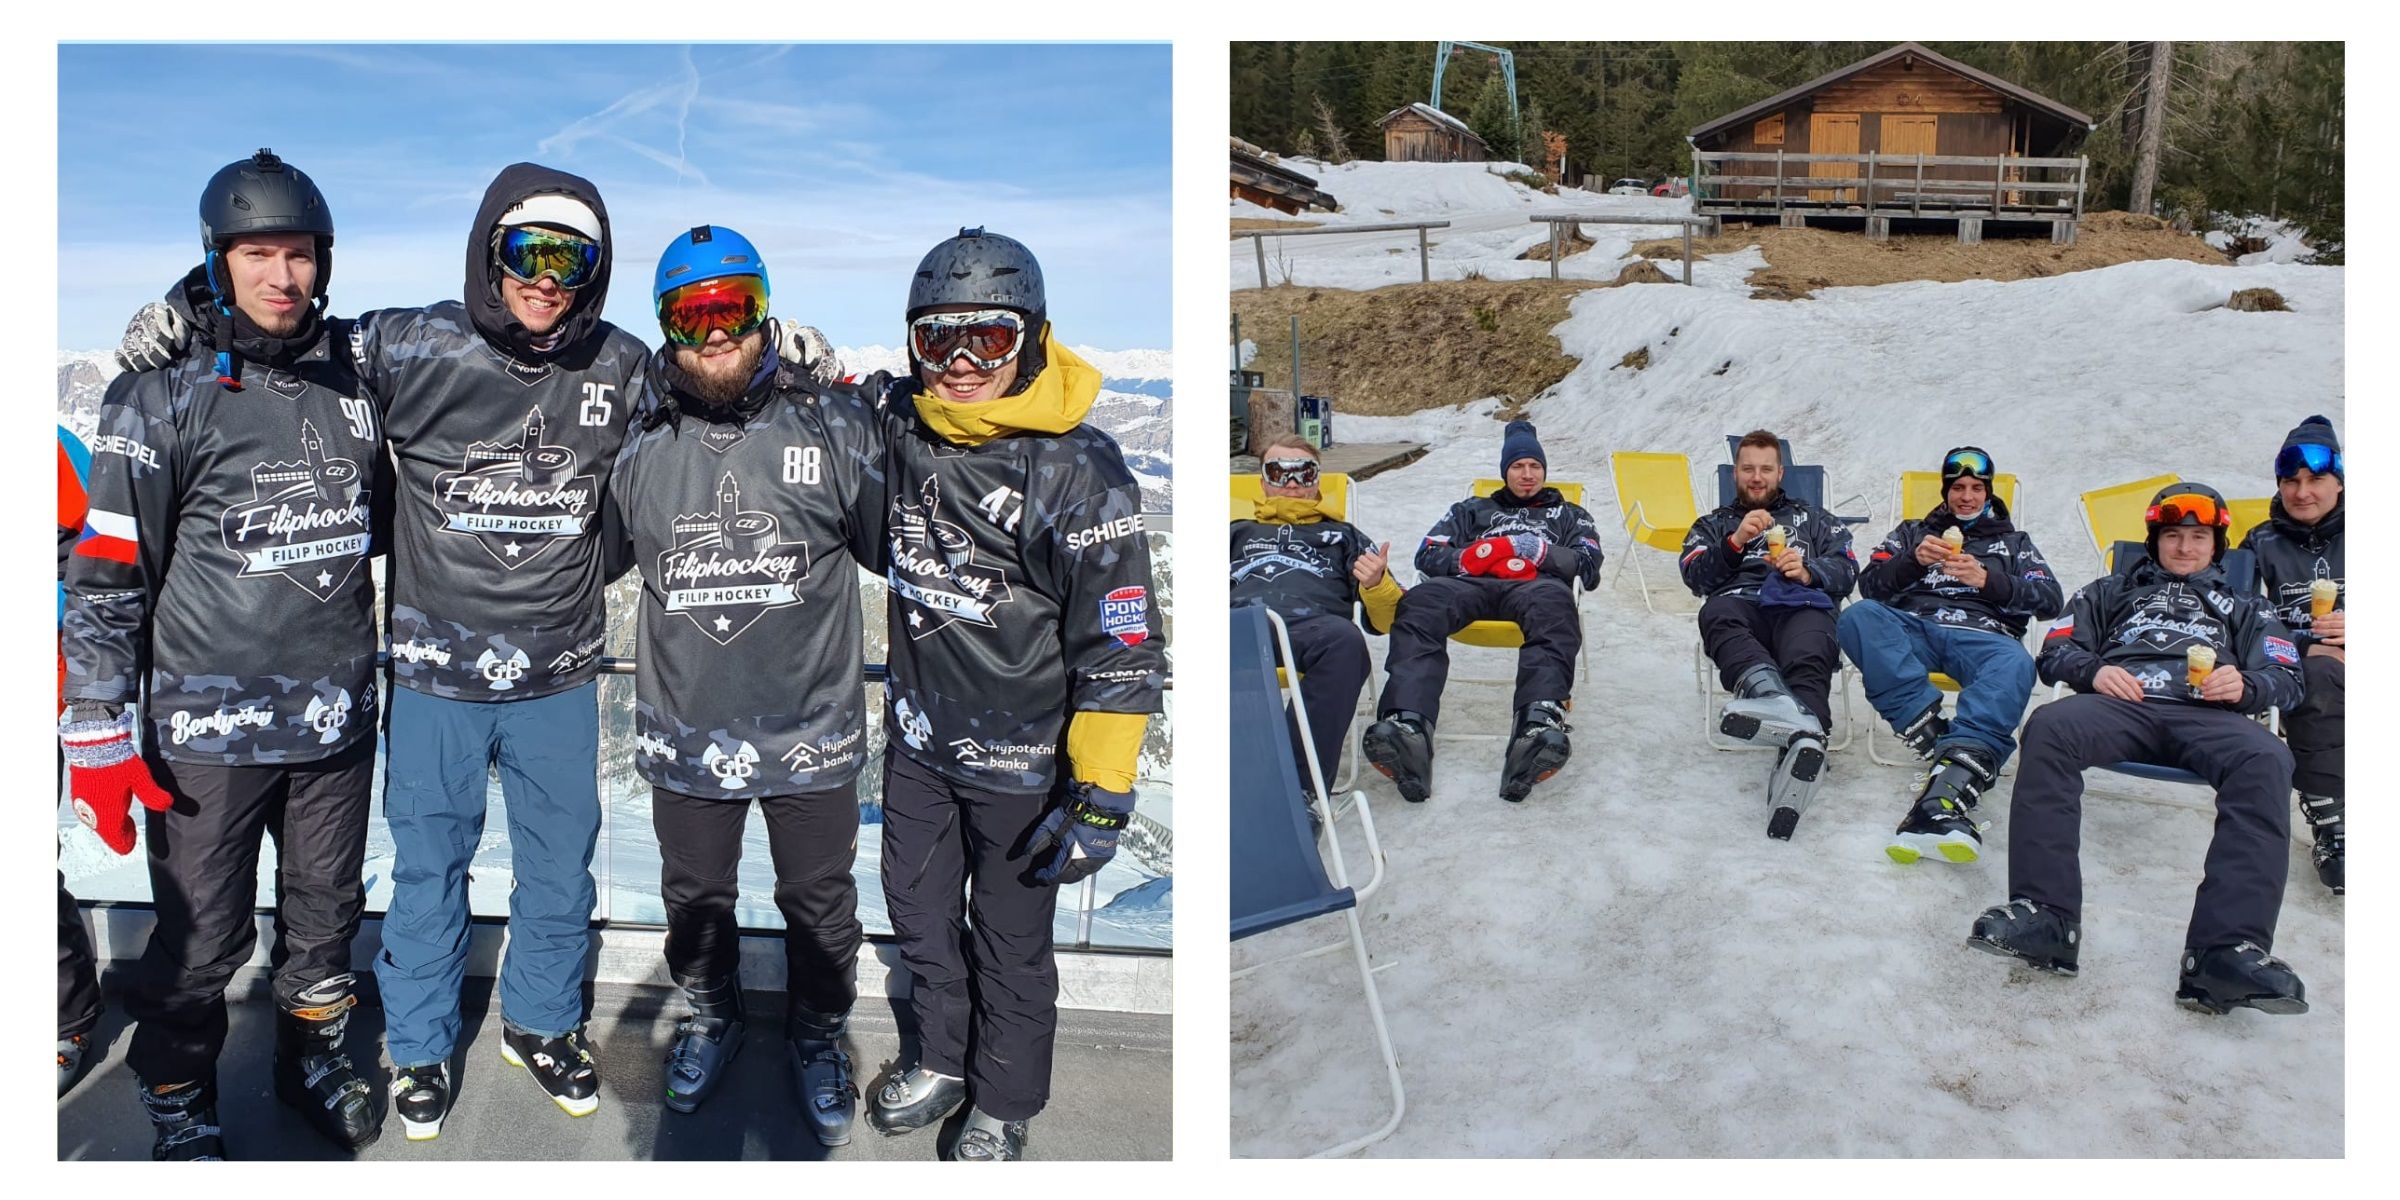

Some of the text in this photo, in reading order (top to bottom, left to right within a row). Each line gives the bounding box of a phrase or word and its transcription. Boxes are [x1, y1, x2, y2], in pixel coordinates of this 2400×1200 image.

[991, 293, 1024, 306] GIRO
[517, 364, 544, 374] YONO
[580, 381, 616, 427] 25
[340, 397, 375, 442] 90
[710, 432, 736, 440] YONO
[537, 452, 562, 464] CZE
[782, 446, 821, 485] 88
[325, 465, 347, 477] CZE
[443, 475, 588, 515] Filiphockey
[467, 517, 563, 530] FILIP HOCKEY
[735, 518, 761, 529] CZE
[1066, 514, 1144, 550] SCHIEDE
[271, 536, 363, 563] FILIP HOCKEY
[664, 549, 798, 589] Filiphockey
[678, 588, 772, 603] FILIP HOCKEY
[909, 586, 963, 609] HOCKEY
[1105, 612, 1146, 627] HOCK
[989, 743, 1057, 756] Hypoteční
[823, 752, 854, 768] banka
[989, 756, 1029, 770] banka
